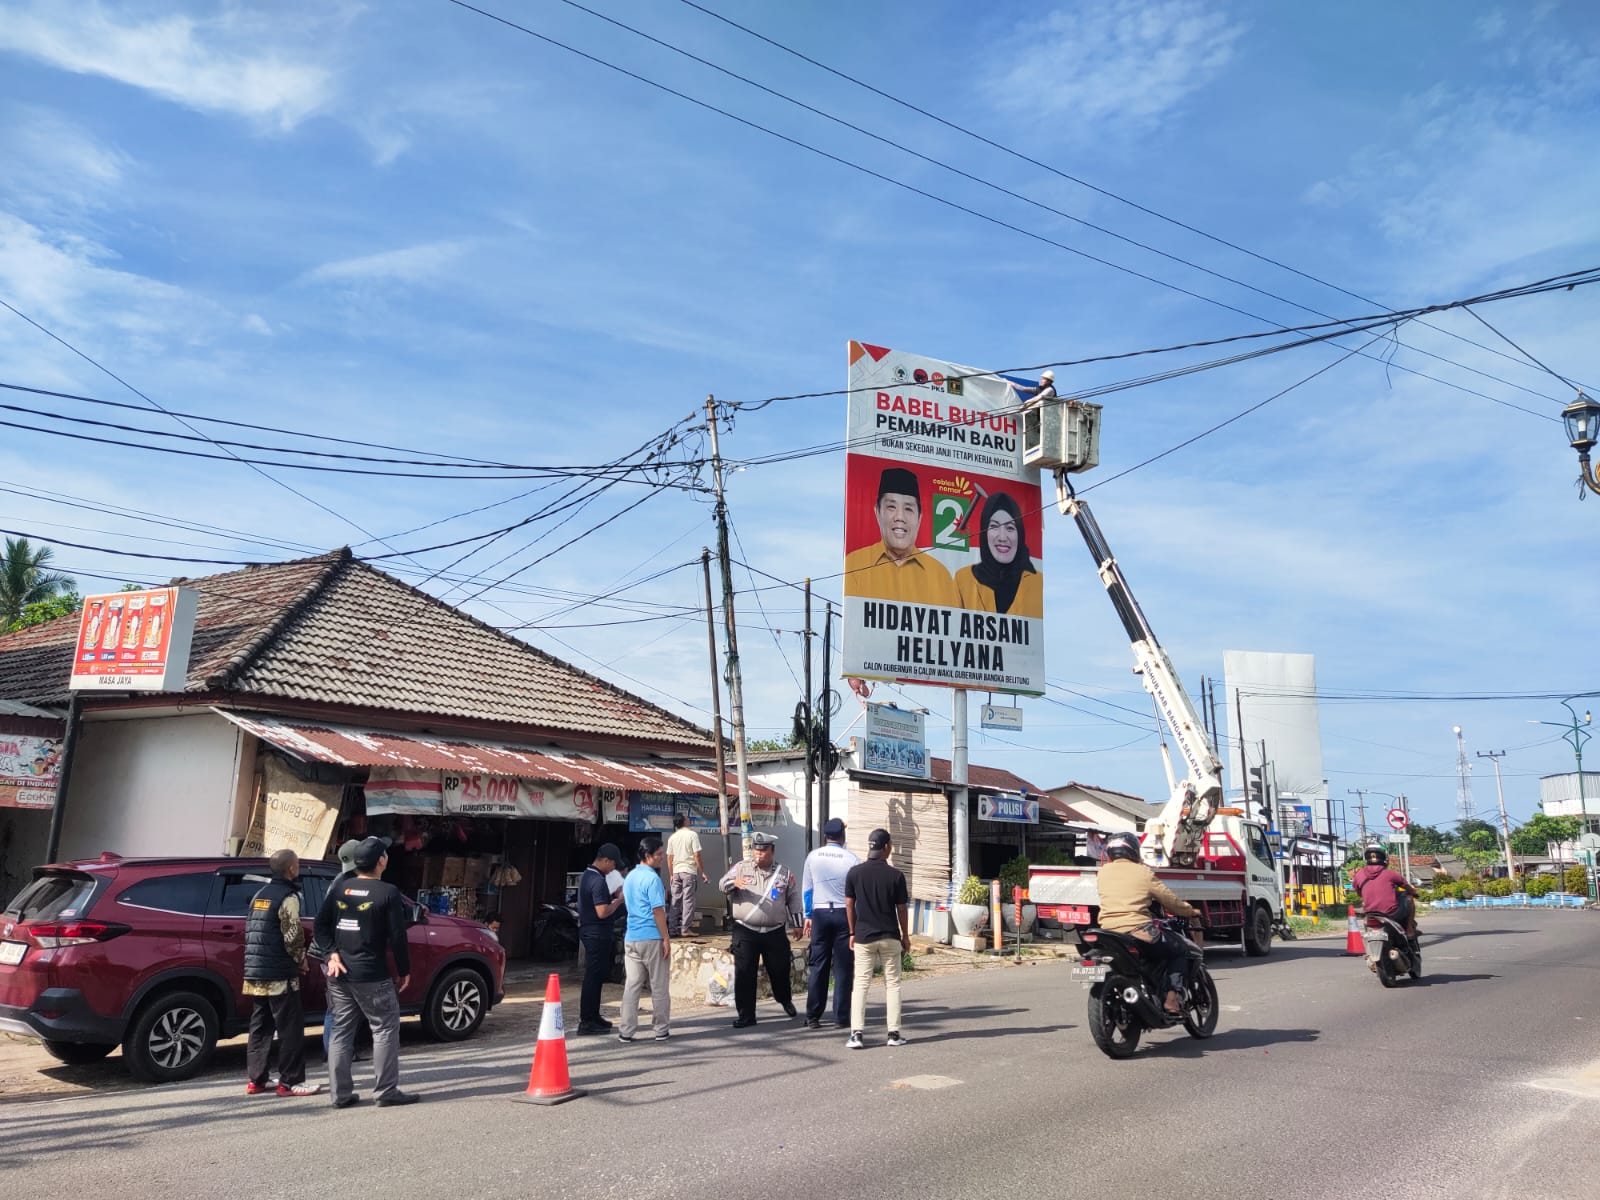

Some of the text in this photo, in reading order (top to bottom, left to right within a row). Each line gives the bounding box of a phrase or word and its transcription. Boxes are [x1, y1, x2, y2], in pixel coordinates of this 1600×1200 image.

[931, 385, 945, 393] PKS
[877, 391, 1017, 435] BABEL BUTUH
[876, 413, 1016, 452] PEMIMPIN BARU
[881, 438, 1013, 469] BUKAN SEKEDAR JANJI TETAPI KERJA NYATA
[939, 485, 962, 495] nomor
[935, 498, 966, 547] 2
[863, 601, 1030, 646] HIDAYAT ARSANI
[897, 635, 1004, 672] HELLYANA
[98, 676, 132, 685] MASA JAYA
[863, 661, 1030, 686] CALON GUBERNUR & CALON WAKIL GUBERNUR BANGKA BELITUNG
[1143, 661, 1204, 780] DISHUB KAB. BANGKA SELATAN
[445, 777, 459, 791] RP
[460, 776, 519, 803] 25.000
[604, 790, 615, 803] RP
[280, 800, 302, 818] Bank
[641, 803, 661, 813] HARGA
[998, 801, 1023, 816] POLISI
